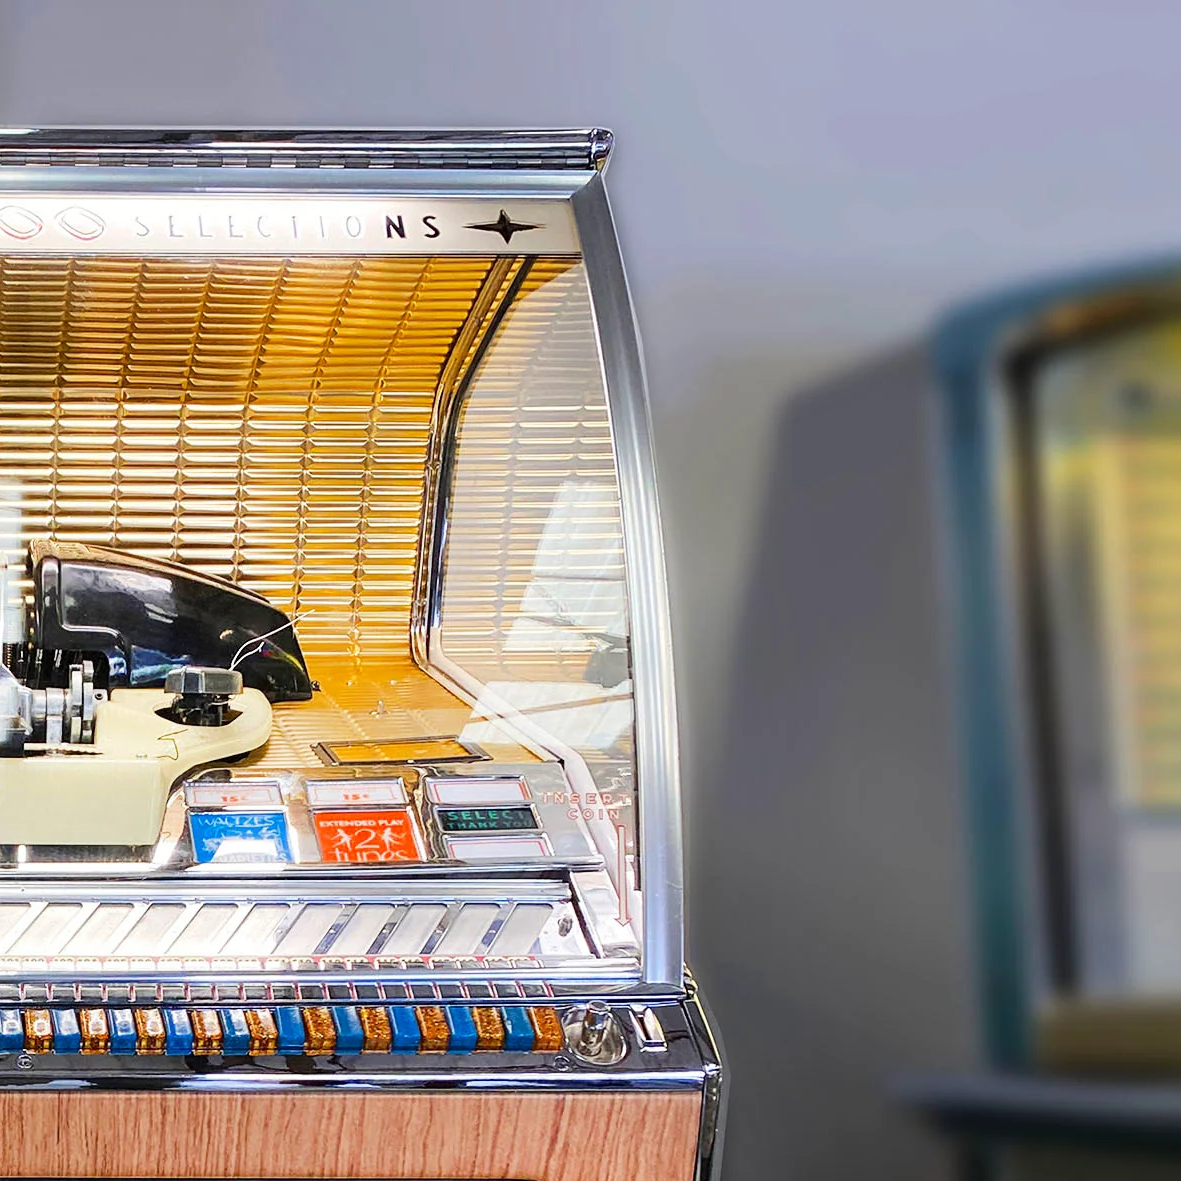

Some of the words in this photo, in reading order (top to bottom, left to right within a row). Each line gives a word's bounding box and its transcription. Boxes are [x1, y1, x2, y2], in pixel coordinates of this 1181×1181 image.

[135, 214, 441, 240] SELECTIONS
[543, 792, 631, 804] INSERT
[446, 809, 525, 821] SELECT
[567, 808, 620, 820] COIN
[198, 815, 276, 828] WALTZES
[319, 820, 376, 828] EXTENDED
[378, 819, 404, 827] PLAY
[447, 821, 498, 830] THANK
[503, 820, 533, 829] YOU
[355, 828, 380, 849] 2
